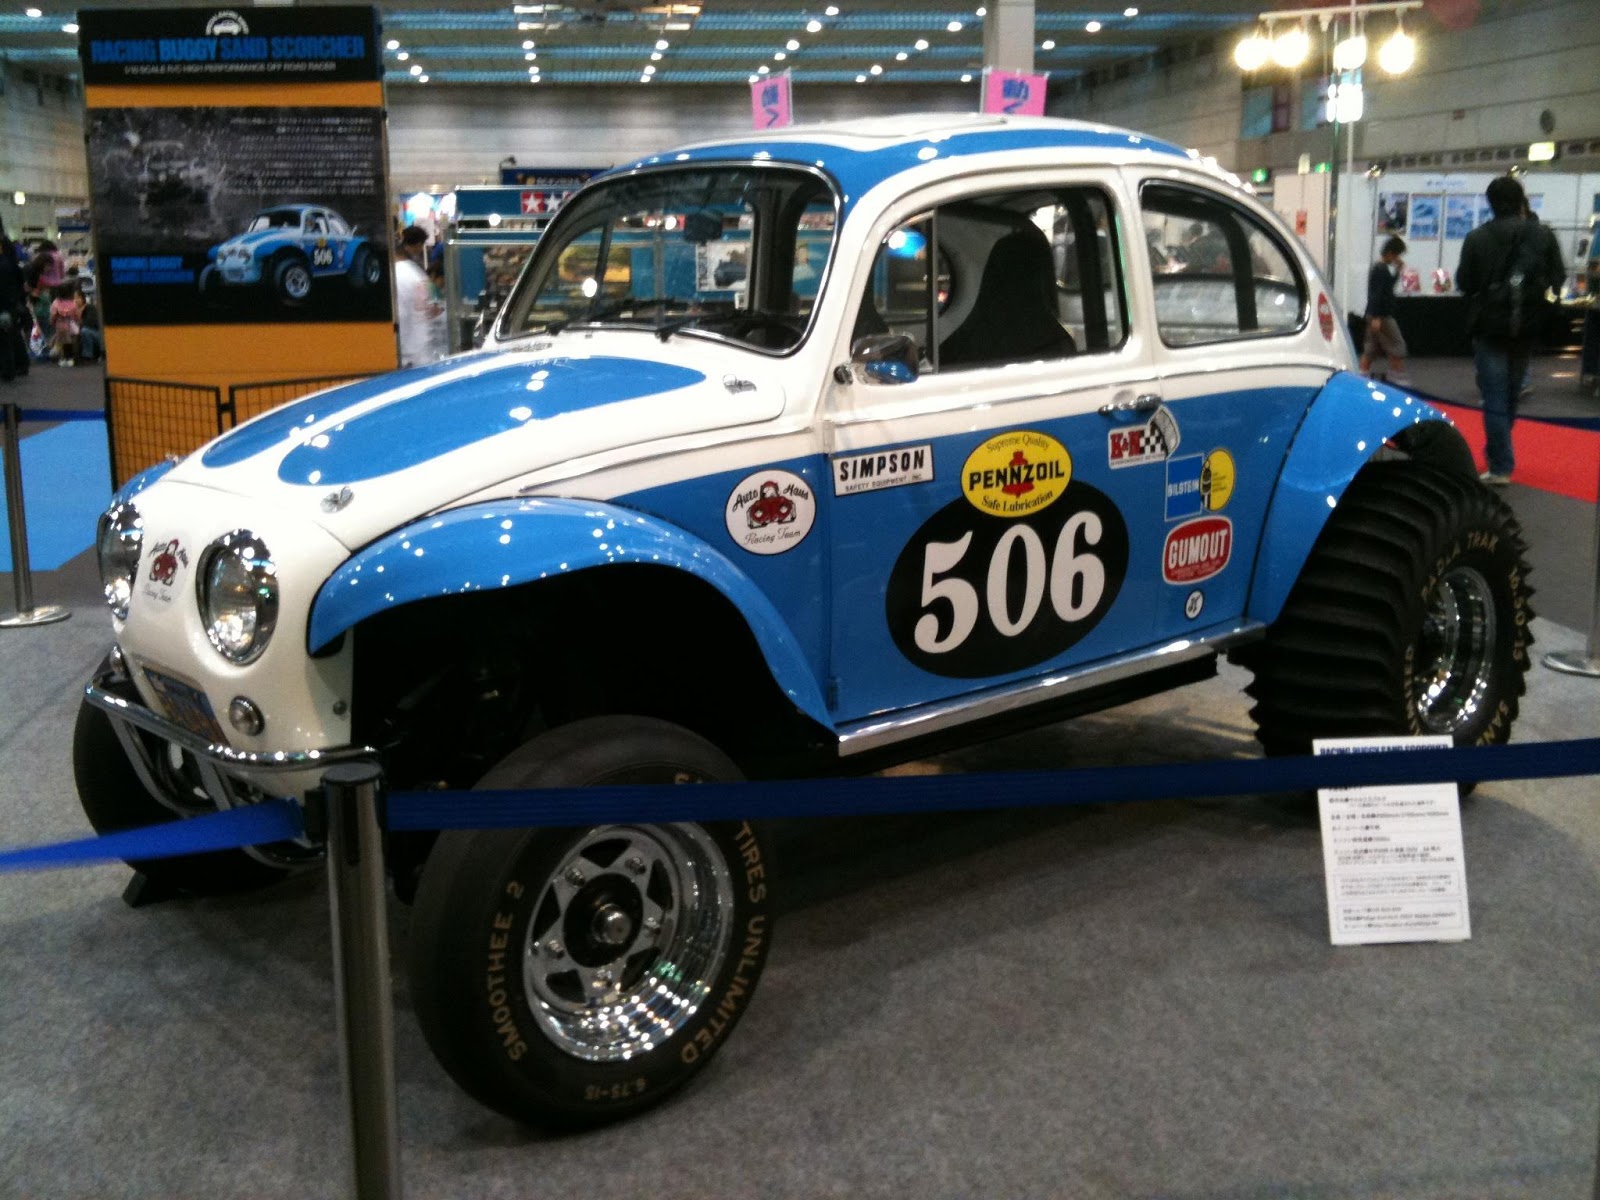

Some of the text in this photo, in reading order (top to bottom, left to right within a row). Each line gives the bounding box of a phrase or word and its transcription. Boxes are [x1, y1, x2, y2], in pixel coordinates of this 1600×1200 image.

[158, 37, 218, 62] BUGGY
[986, 433, 1051, 453] Supreme Quality
[839, 449, 925, 482] SIMPSON
[968, 458, 1065, 491] PENNZOIL
[732, 483, 809, 512] Auto Haus
[845, 481, 870, 493] SAFETY
[981, 489, 1054, 512] Safe Lubrication
[1168, 478, 1200, 498] BILSTEIN
[743, 527, 802, 546] Racing Team
[1167, 529, 1229, 570] GUMOUT
[1467, 531, 1500, 553] TRAK
[914, 511, 1105, 654] 506
[680, 820, 767, 1064] TIRES UNLIMITED
[486, 880, 528, 1062] SMOOTHEE 2
